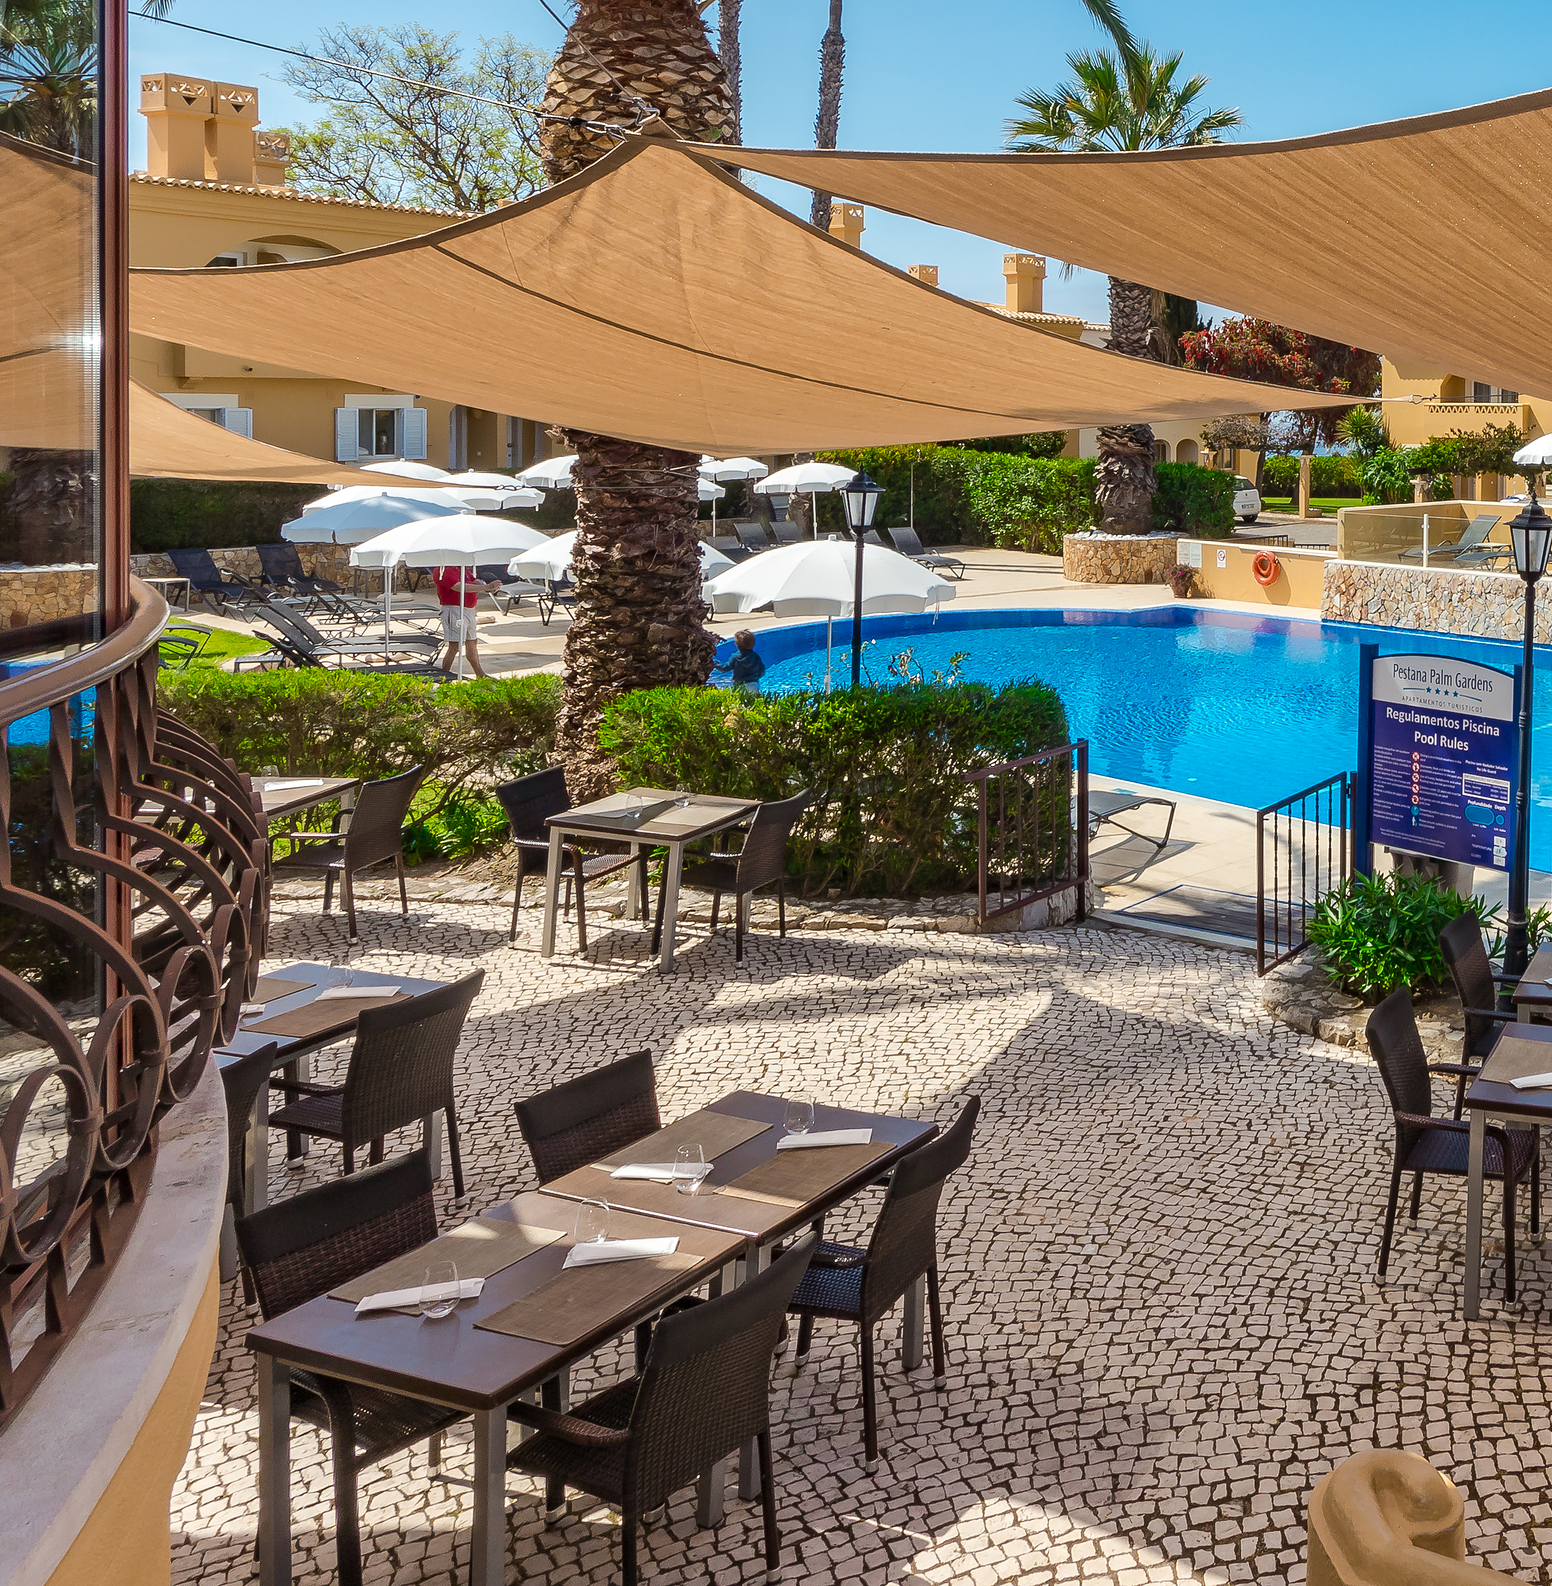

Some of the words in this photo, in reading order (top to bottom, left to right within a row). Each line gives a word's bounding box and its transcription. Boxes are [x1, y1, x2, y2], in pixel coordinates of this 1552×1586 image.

[1393, 663, 1427, 683] Pestana
[1430, 668, 1452, 686] Palm
[1455, 672, 1493, 693] Gardens
[1401, 695, 1446, 707] APARTAMENTOS
[1386, 707, 1460, 730] Regulamentos
[1462, 718, 1500, 737] Piscina
[1414, 731, 1437, 746] Pool
[1440, 735, 1469, 751] Rules
